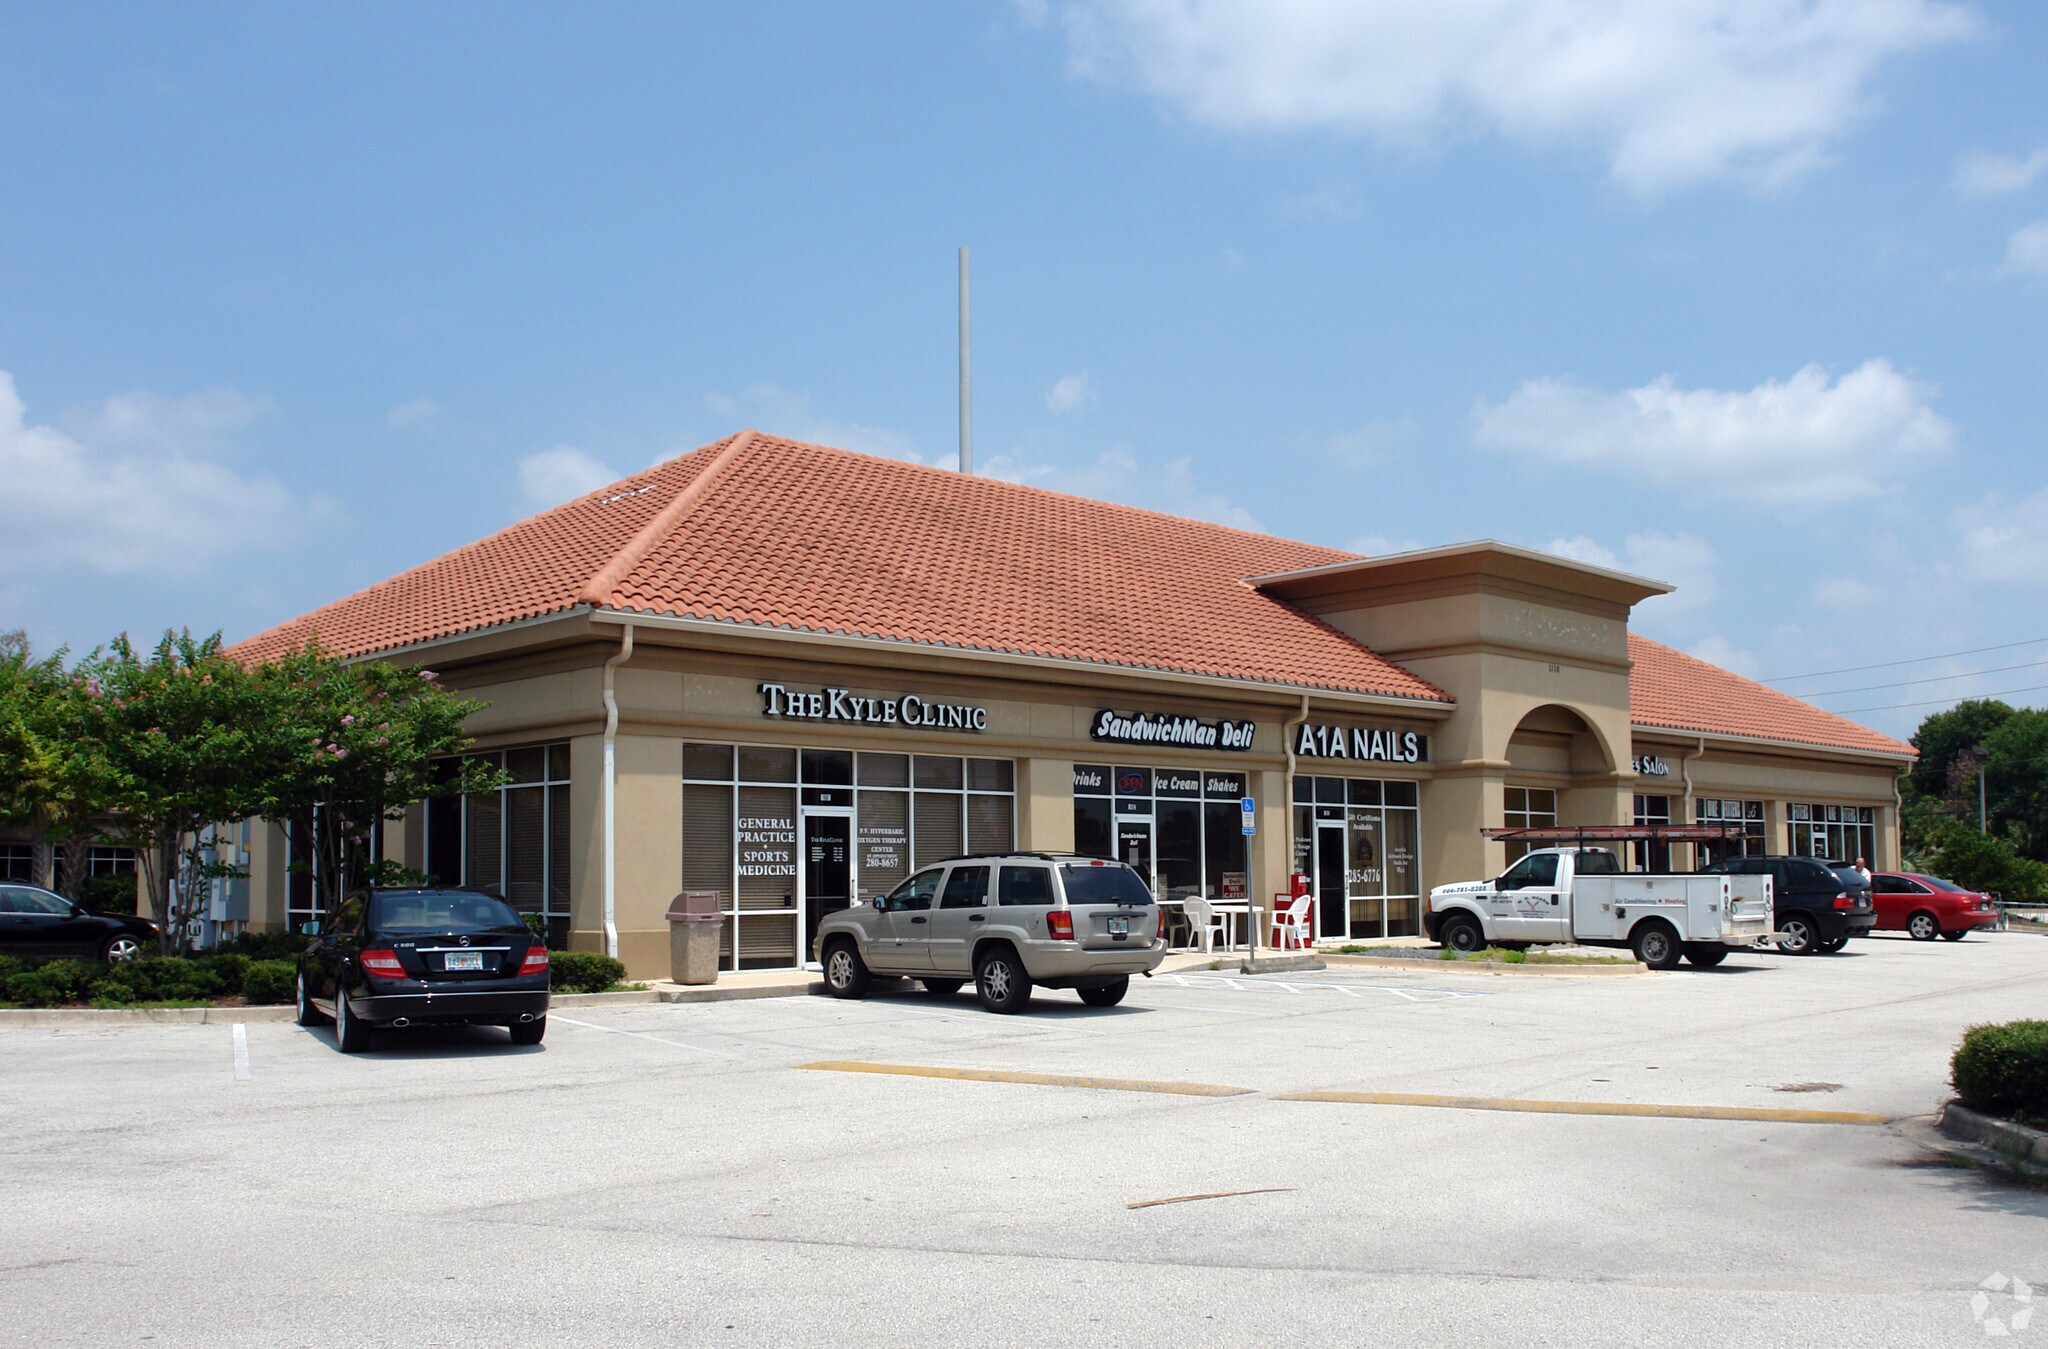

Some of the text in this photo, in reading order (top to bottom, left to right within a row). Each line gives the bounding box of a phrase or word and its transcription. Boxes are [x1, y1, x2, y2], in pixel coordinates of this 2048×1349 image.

[1096, 710, 1255, 748] SandwichMan Deli
[1298, 723, 1419, 763] A1A NAILS
[1118, 776, 1144, 790] OPEN
[1170, 776, 1199, 791] Cream
[1206, 778, 1239, 793] Shakes
[738, 818, 794, 829] GENERAL
[737, 831, 796, 843] PRACTICE
[743, 851, 789, 862] SPORTS
[866, 858, 899, 868] 280-8657
[737, 864, 796, 876] MEDICINE
[1347, 868, 1381, 883] 285-6776
